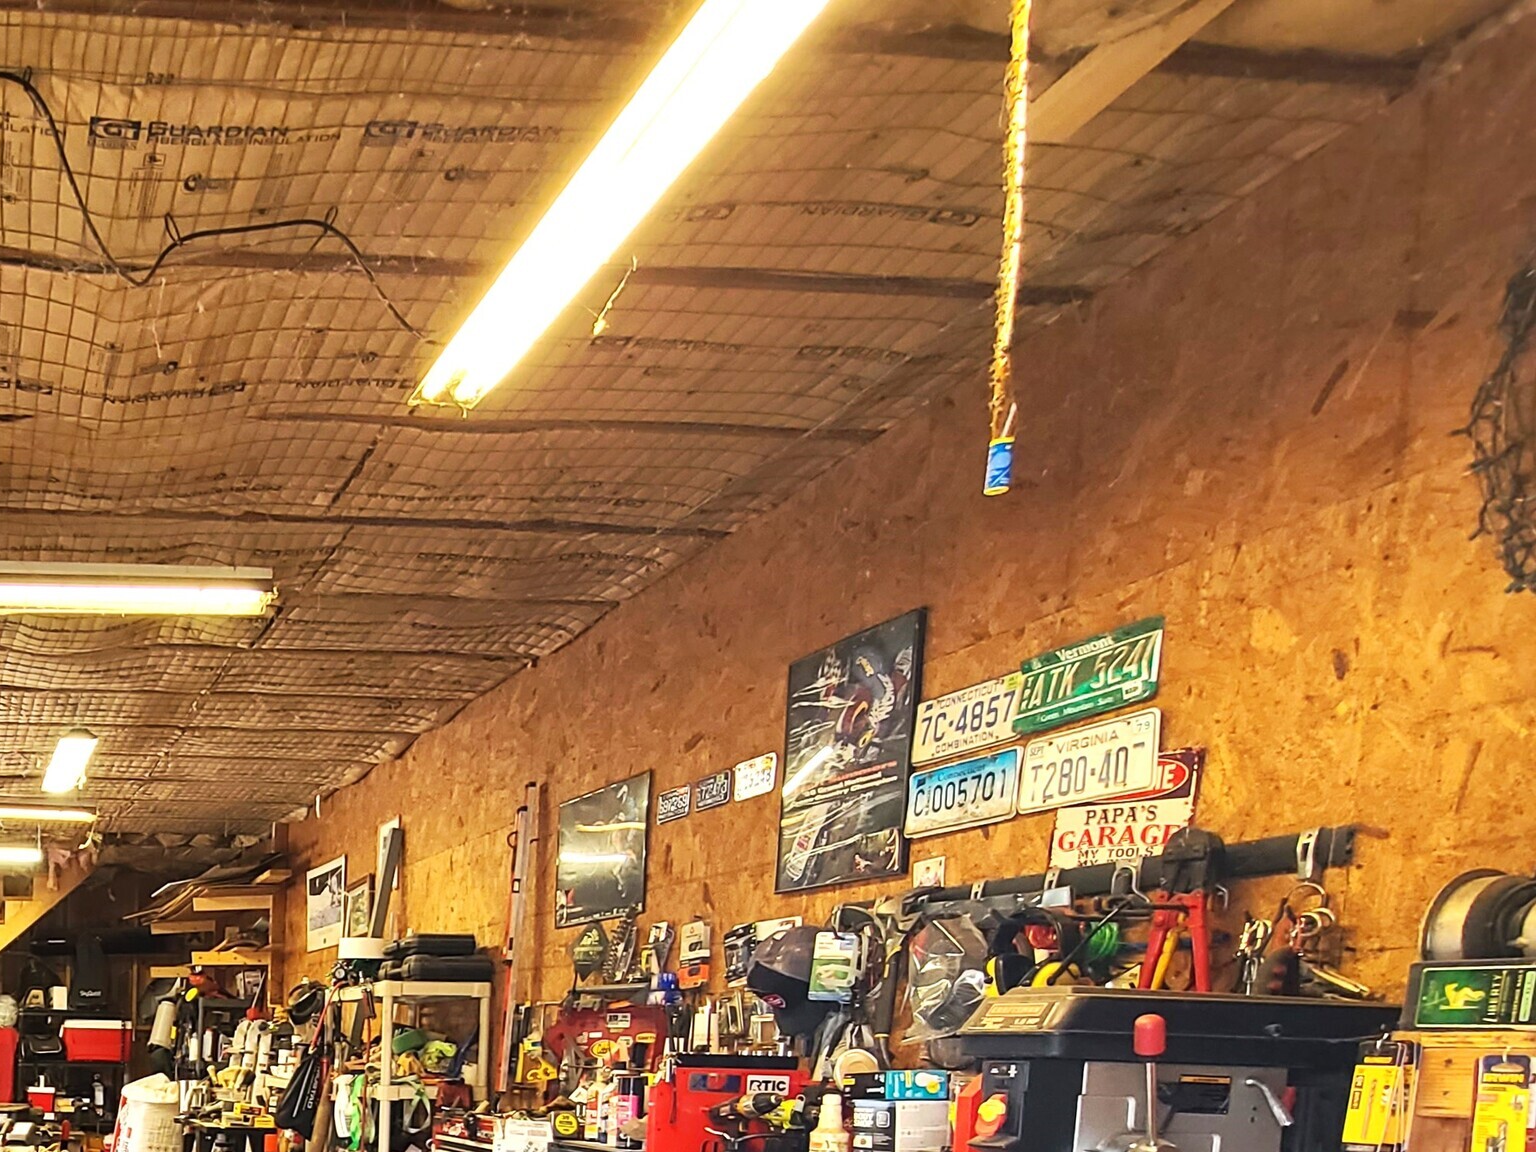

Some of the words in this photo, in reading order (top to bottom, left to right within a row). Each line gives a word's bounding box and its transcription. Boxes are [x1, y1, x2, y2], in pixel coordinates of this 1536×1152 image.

[146, 134, 247, 146] FIBERGLASS
[249, 132, 342, 146] INSULATION
[147, 120, 290, 139] GUARDIAN
[1055, 635, 1115, 662] Vermont
[937, 681, 1000, 710] CONNECTICUT
[935, 731, 995, 755] COMBINATION
[1056, 730, 1120, 755] VIRGINIA
[1086, 805, 1158, 826] PAPA'S
[1077, 847, 1100, 860] MY
[750, 1079, 788, 1093] RTIC
